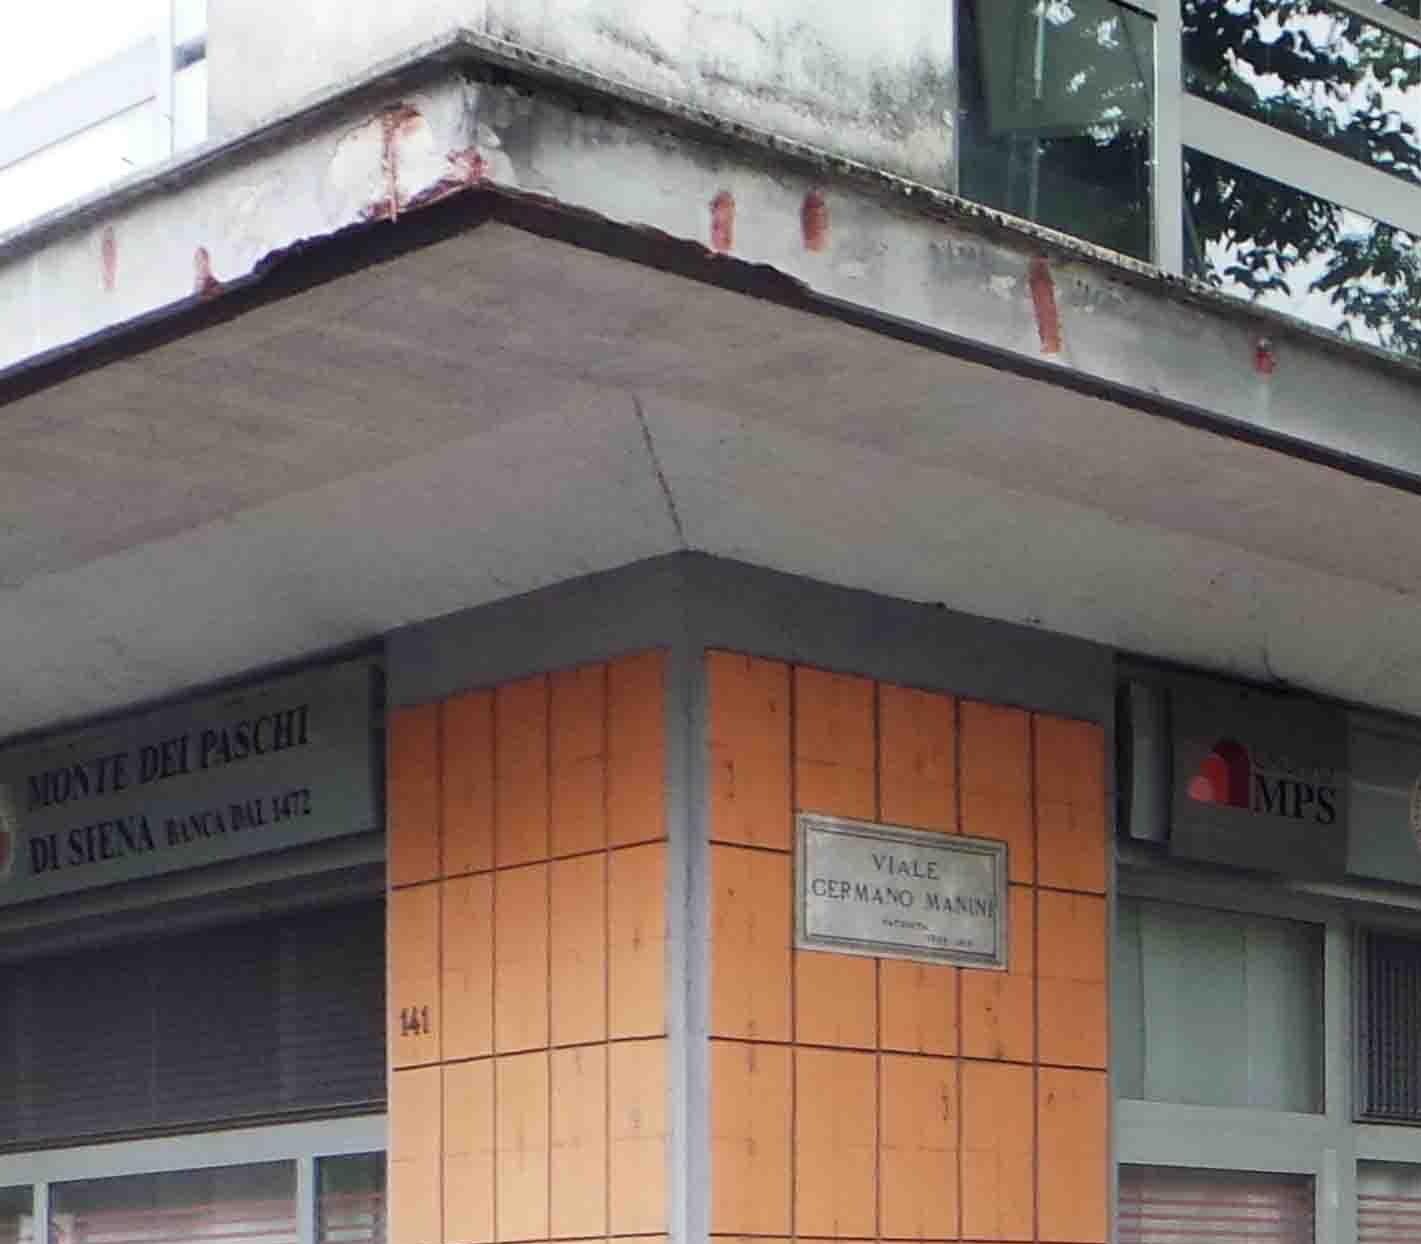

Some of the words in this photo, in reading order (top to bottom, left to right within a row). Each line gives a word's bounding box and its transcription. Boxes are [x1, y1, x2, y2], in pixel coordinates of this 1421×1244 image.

[26, 752, 129, 812] MONTE
[138, 733, 192, 784] DEI
[198, 703, 311, 769] PASCHI
[1252, 774, 1337, 824] MPS
[29, 832, 61, 873] DI
[66, 815, 156, 867] SIENA
[163, 810, 226, 847] BANCA
[227, 797, 268, 831] DAL
[271, 787, 312, 823] 1472
[871, 852, 940, 881] VIALE
[810, 877, 914, 909] GERMANO
